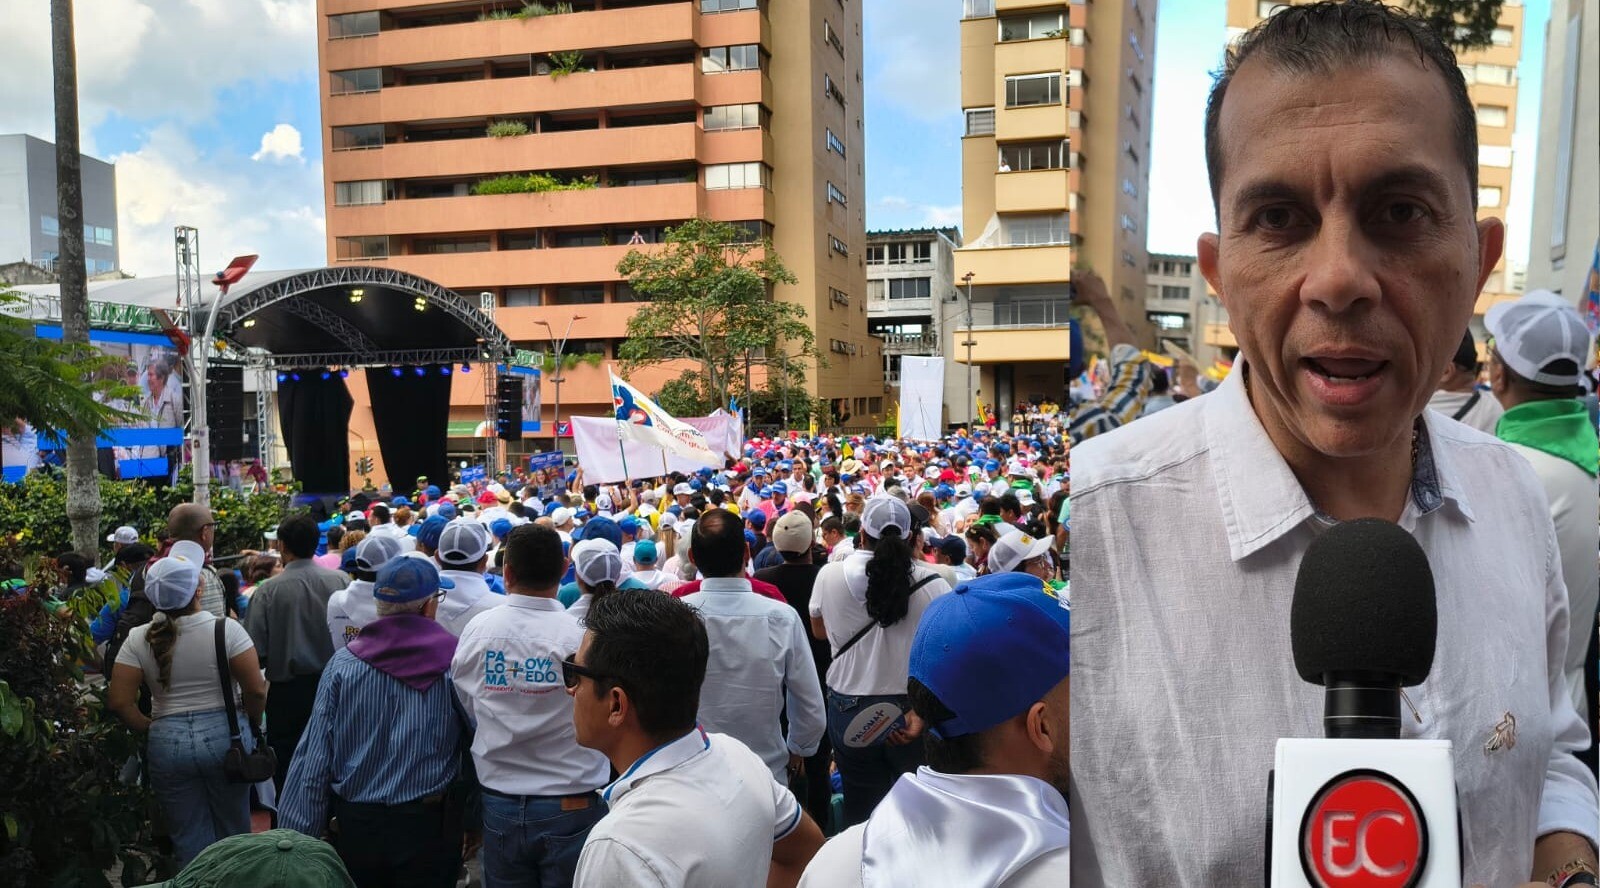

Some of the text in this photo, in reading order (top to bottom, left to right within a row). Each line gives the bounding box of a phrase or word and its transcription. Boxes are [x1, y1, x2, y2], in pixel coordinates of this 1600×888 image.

[485, 650, 505, 661] PA
[485, 662, 505, 674] LO
[485, 674, 508, 686] MA
[525, 670, 557, 683] EDO
